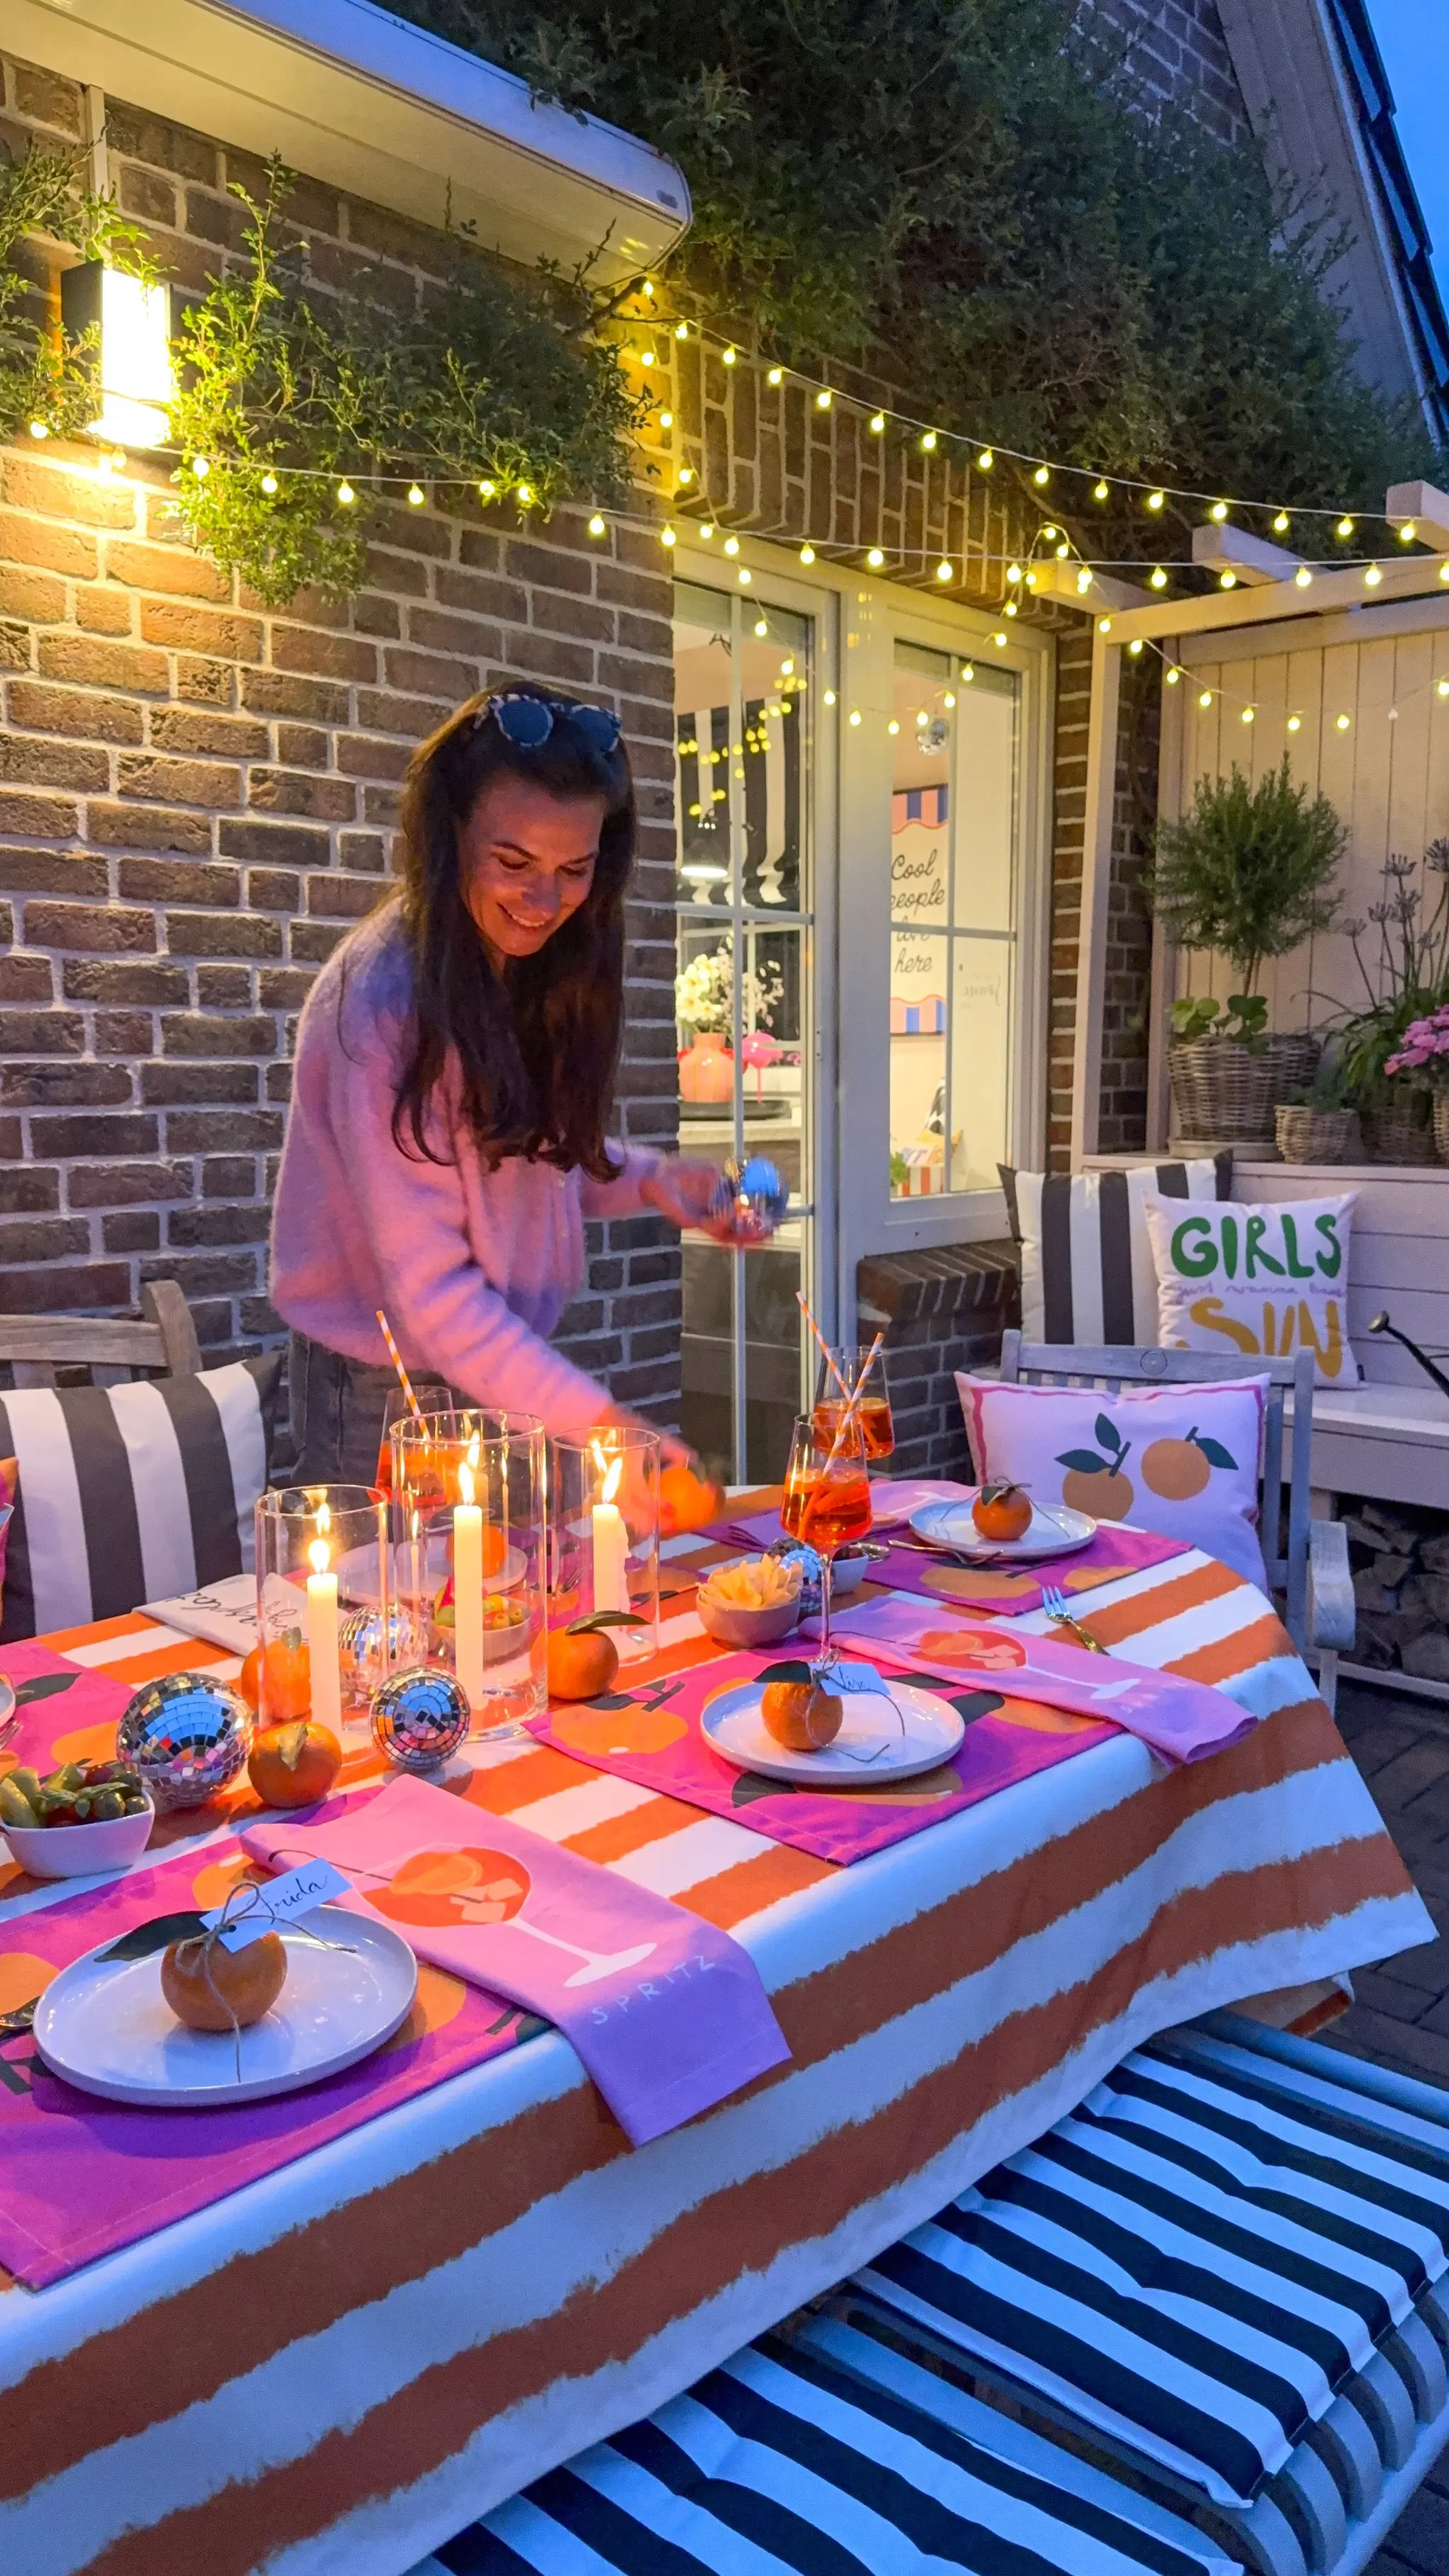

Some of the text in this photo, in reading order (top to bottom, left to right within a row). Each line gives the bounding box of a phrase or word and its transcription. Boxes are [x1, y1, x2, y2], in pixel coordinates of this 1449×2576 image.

[891, 848, 937, 881] Cool
[894, 947, 933, 974] here
[1170, 1214, 1341, 1279] GIRLS
[246, 1875, 328, 1925] Frida
[591, 1956, 715, 2025] SPRITZ
